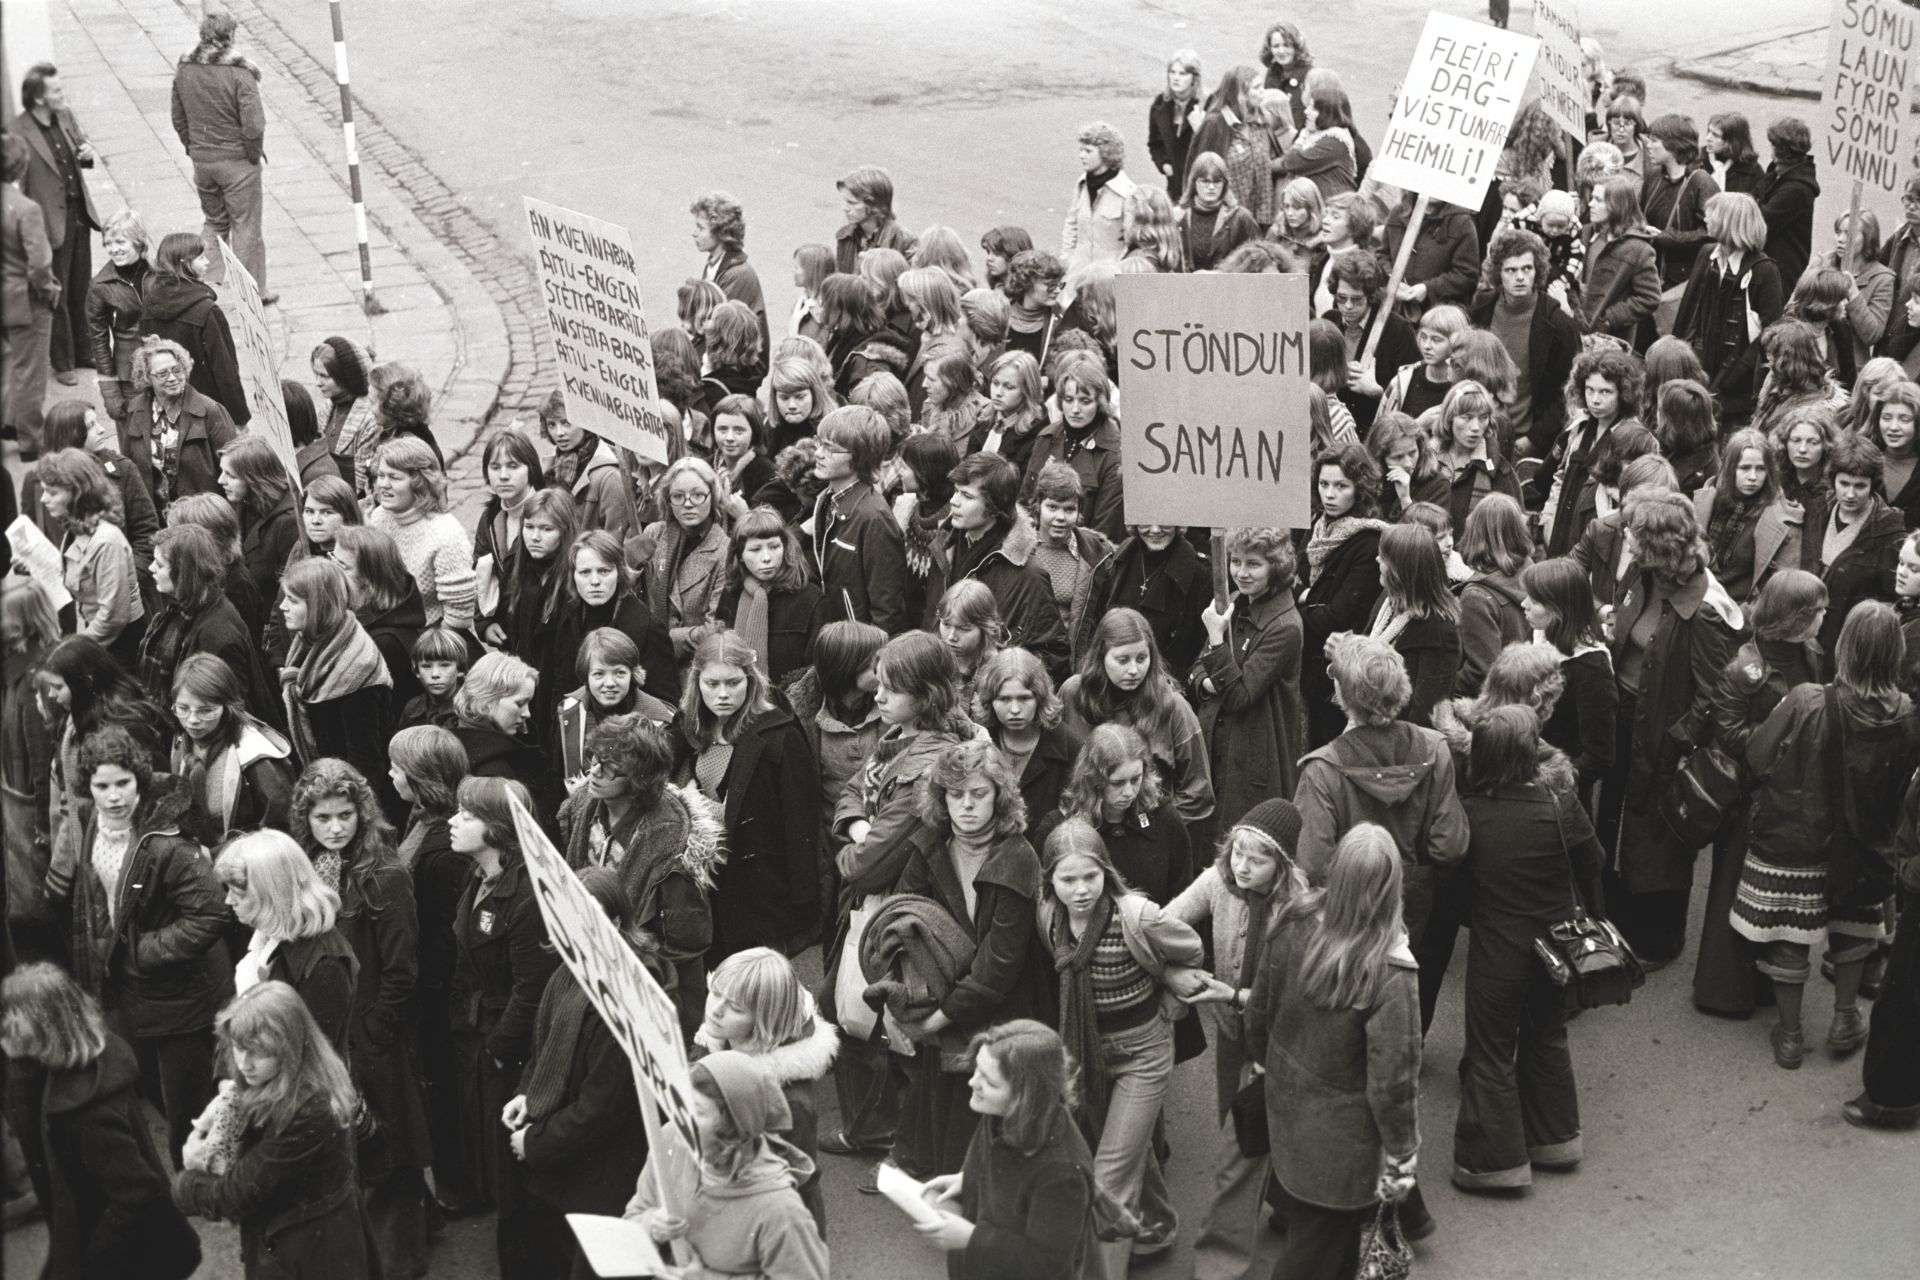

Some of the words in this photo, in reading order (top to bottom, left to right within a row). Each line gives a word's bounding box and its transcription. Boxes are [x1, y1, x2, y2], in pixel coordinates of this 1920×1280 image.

[1430, 36, 1518, 81] FLEIRI
[1839, 39, 1907, 92] LAUN
[1431, 67, 1511, 106] DAG-
[1834, 73, 1899, 123] FYRIR
[1386, 129, 1485, 185] HEIMILI!
[1831, 106, 1898, 155] SÖMU
[1827, 135, 1897, 191] VINNU
[1130, 322, 1304, 376] STÖNDUM
[1138, 422, 1284, 484] SAMAN
